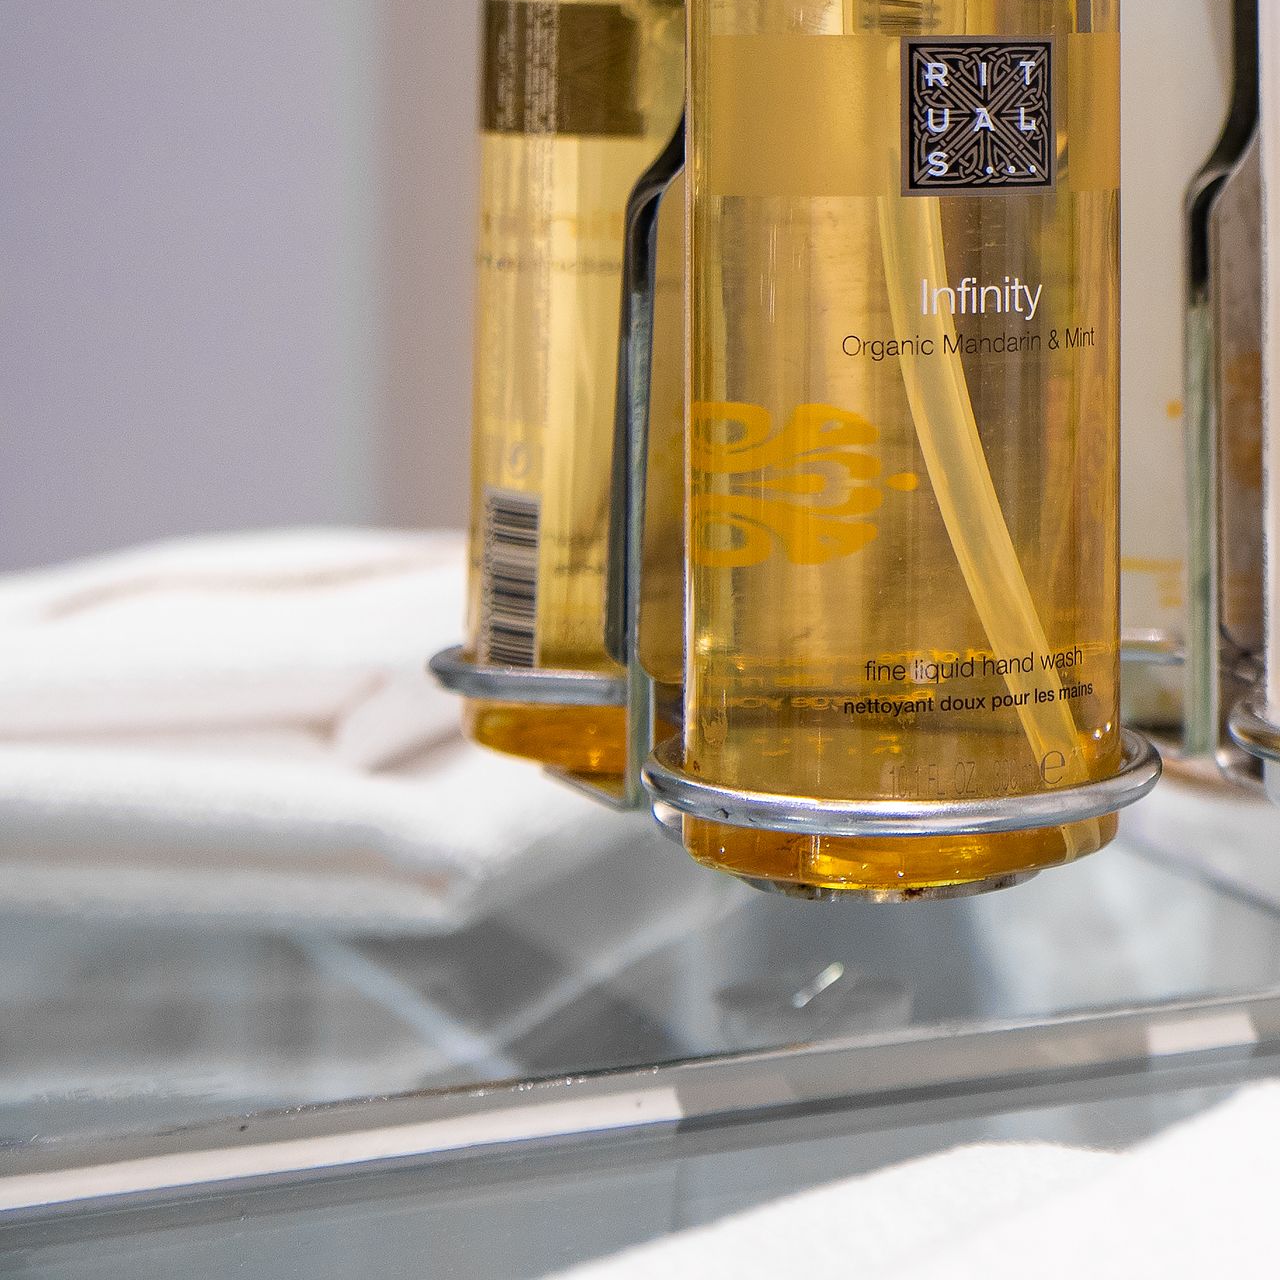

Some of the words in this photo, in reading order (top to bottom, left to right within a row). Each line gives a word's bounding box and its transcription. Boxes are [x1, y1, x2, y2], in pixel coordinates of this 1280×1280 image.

[925, 61, 1036, 87] RIT
[927, 107, 1037, 133] UAL
[920, 276, 1043, 320] Infinity
[842, 335, 934, 361] Organic
[943, 331, 1042, 354] Mandarin
[1048, 329, 1060, 350] &
[1065, 327, 1095, 349] Mint
[865, 660, 906, 681] fine
[915, 657, 974, 684] liquid
[983, 652, 1034, 676] hand
[1040, 646, 1083, 670] wash
[844, 696, 934, 717] nettoyant
[940, 695, 986, 711] doux
[992, 691, 1029, 711] pour
[1034, 687, 1055, 704] les
[1059, 681, 1093, 701] mains
